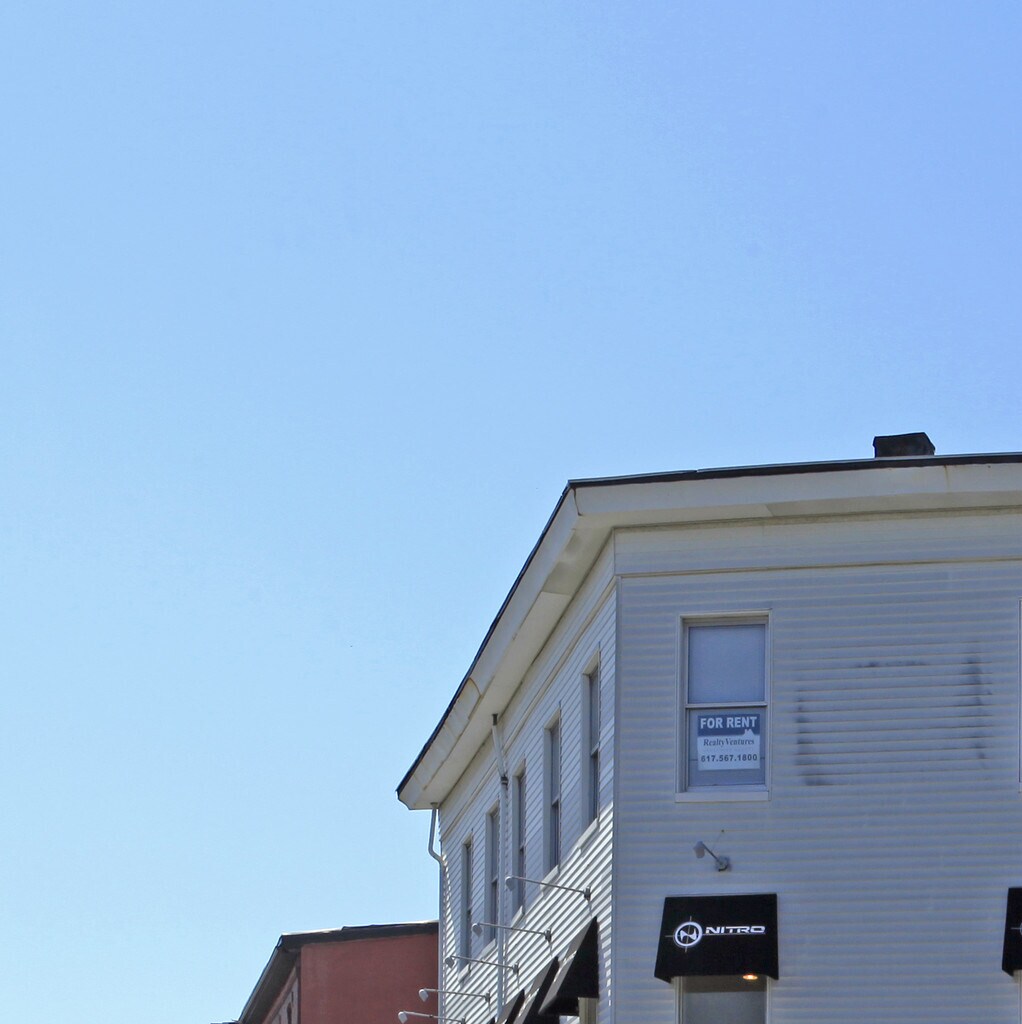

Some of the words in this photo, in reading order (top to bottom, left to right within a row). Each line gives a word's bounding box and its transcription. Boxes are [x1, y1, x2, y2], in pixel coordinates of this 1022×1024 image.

[700, 717, 723, 729] FOR
[726, 716, 757, 728] RENT
[701, 754, 757, 762] 617.567.1800
[705, 925, 766, 934] NITRO
